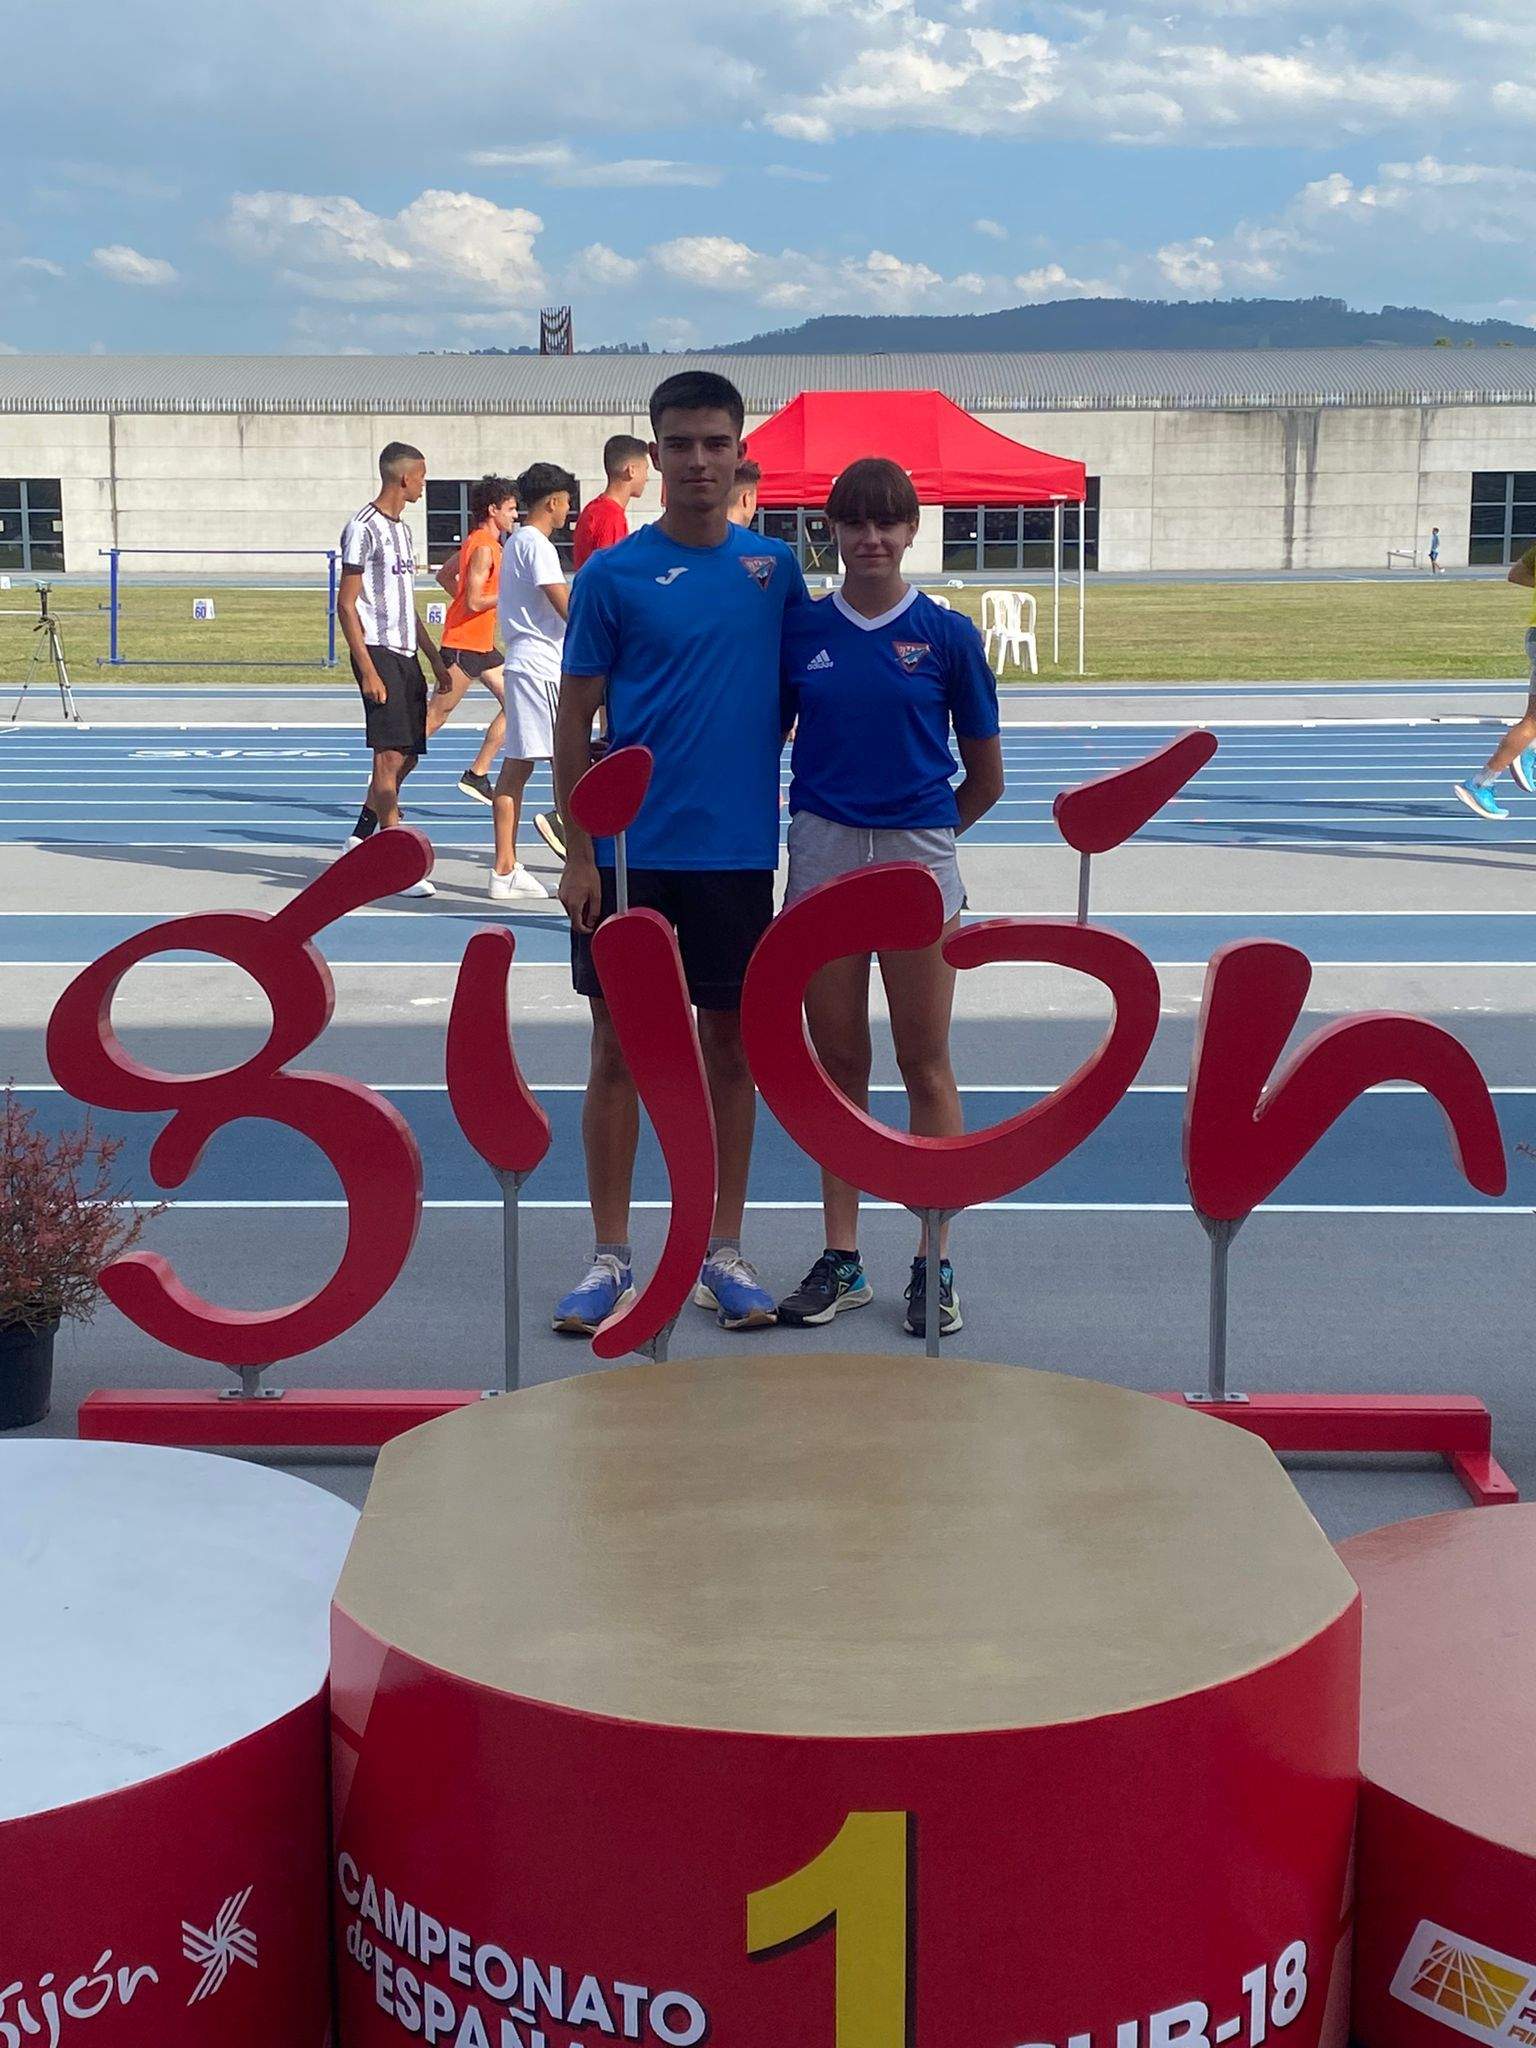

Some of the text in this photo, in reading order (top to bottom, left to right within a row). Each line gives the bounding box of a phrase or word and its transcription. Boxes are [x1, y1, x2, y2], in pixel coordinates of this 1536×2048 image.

[195, 606, 207, 619] 60
[428, 610, 442, 624] 65
[45, 730, 1508, 1363] gijón
[338, 1851, 707, 2047] CAMPEONATO
[346, 1919, 587, 2048] de ESPAÑ
[746, 1811, 908, 2048] 1
